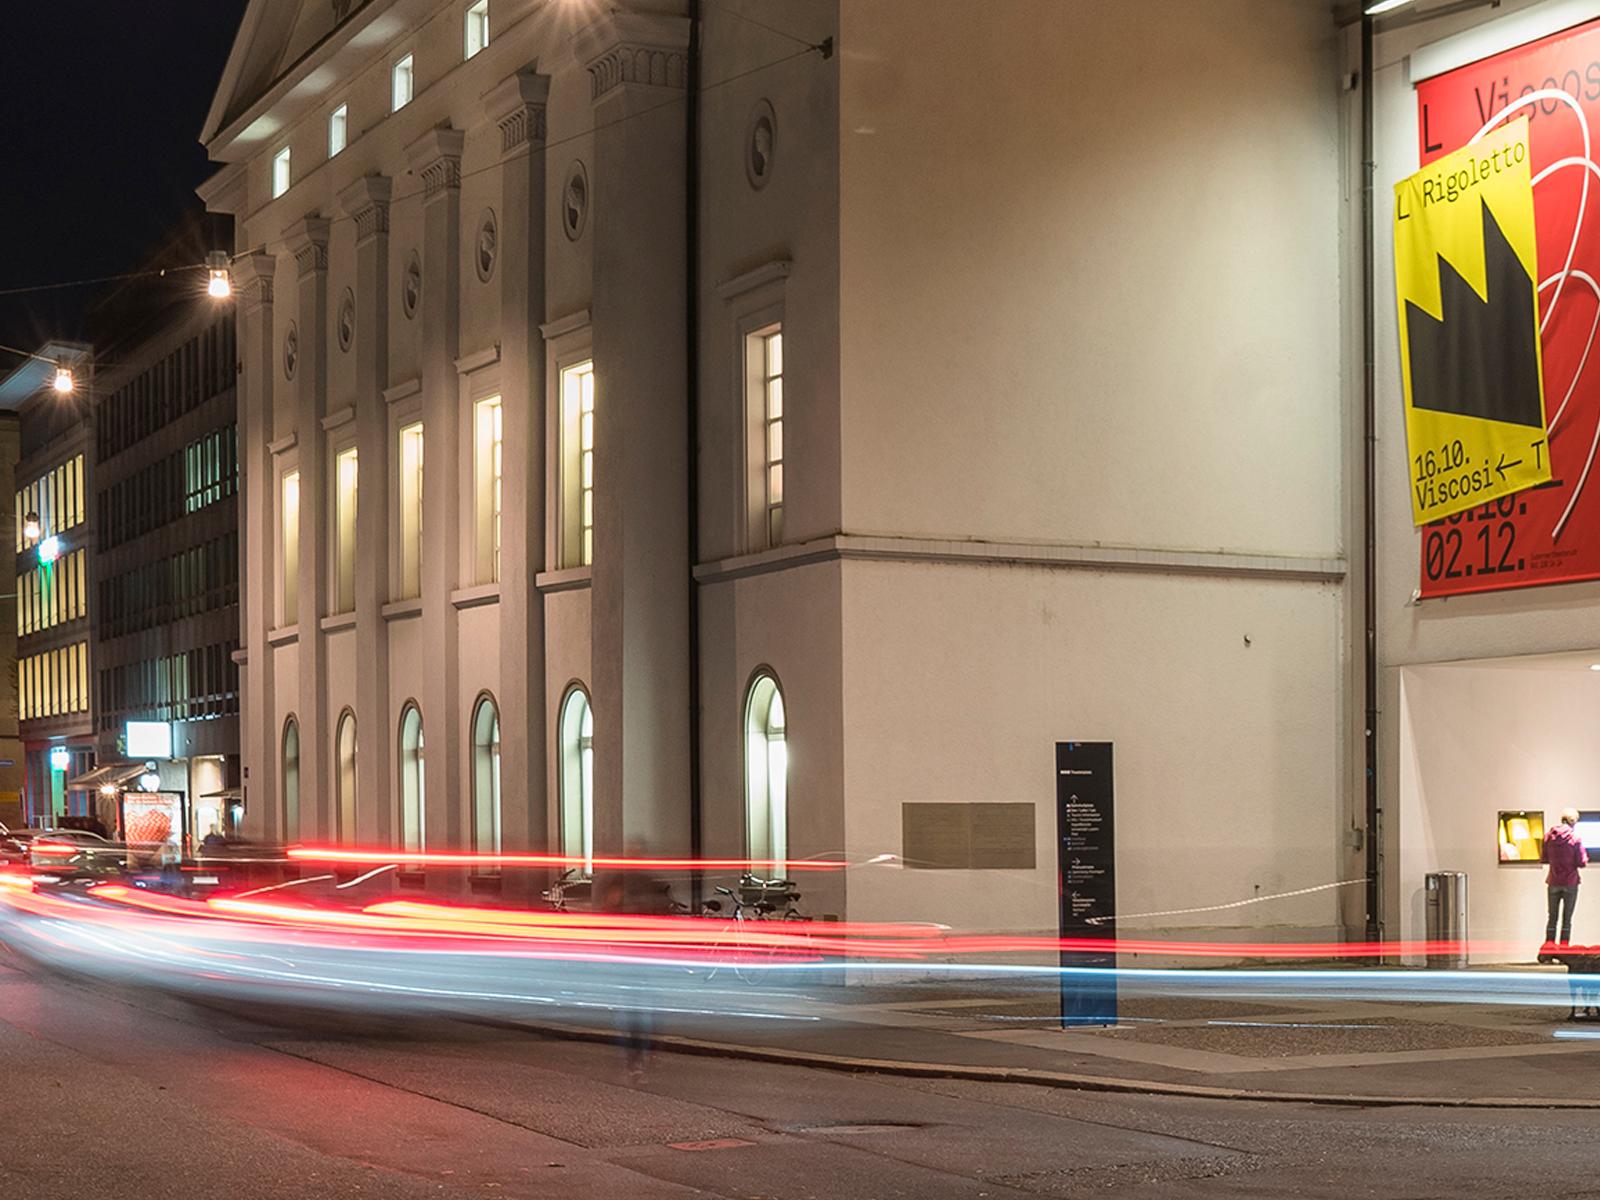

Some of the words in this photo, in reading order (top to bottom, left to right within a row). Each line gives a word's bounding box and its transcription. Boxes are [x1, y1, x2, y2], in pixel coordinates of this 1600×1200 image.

[1423, 103, 1443, 154] L
[1397, 195, 1410, 220] L
[1421, 141, 1526, 209] Rigoletto
[1414, 439, 1470, 483] 16.10.
[1531, 440, 1544, 469] T
[1415, 460, 1494, 511] Viscosi
[1425, 520, 1526, 582] 02.12.
